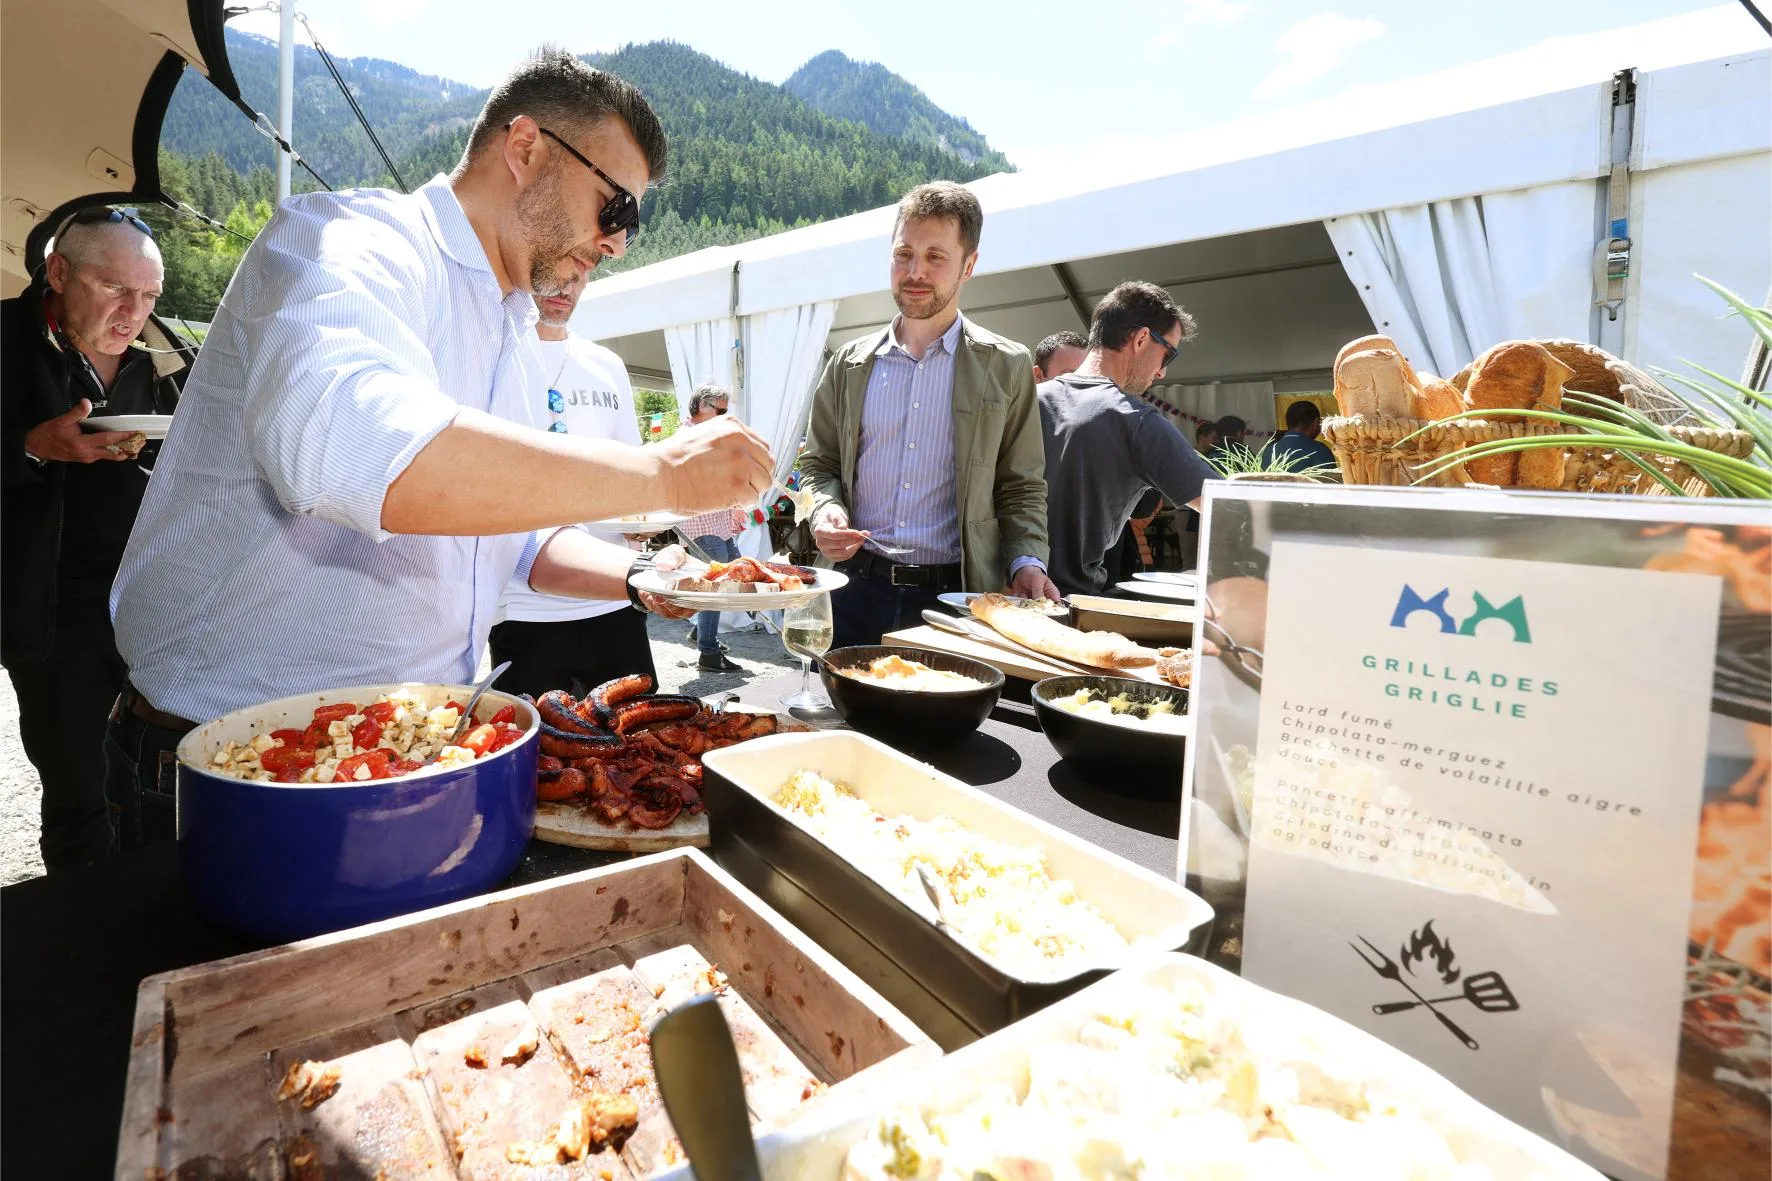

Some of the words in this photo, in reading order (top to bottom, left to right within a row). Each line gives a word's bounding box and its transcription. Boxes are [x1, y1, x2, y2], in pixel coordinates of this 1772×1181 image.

[568, 389, 619, 410] JEANS
[1362, 655, 1559, 696] GRILLADES
[1282, 701, 1329, 717] Lard
[1340, 710, 1393, 729] fumé
[1384, 683, 1527, 718] GRIGLIE
[1281, 716, 1507, 769] Chipolata-merguez
[1279, 748, 1337, 769] douce
[1400, 757, 1424, 771] de
[1567, 793, 1642, 817] aigre
[1528, 876, 1551, 891] in
